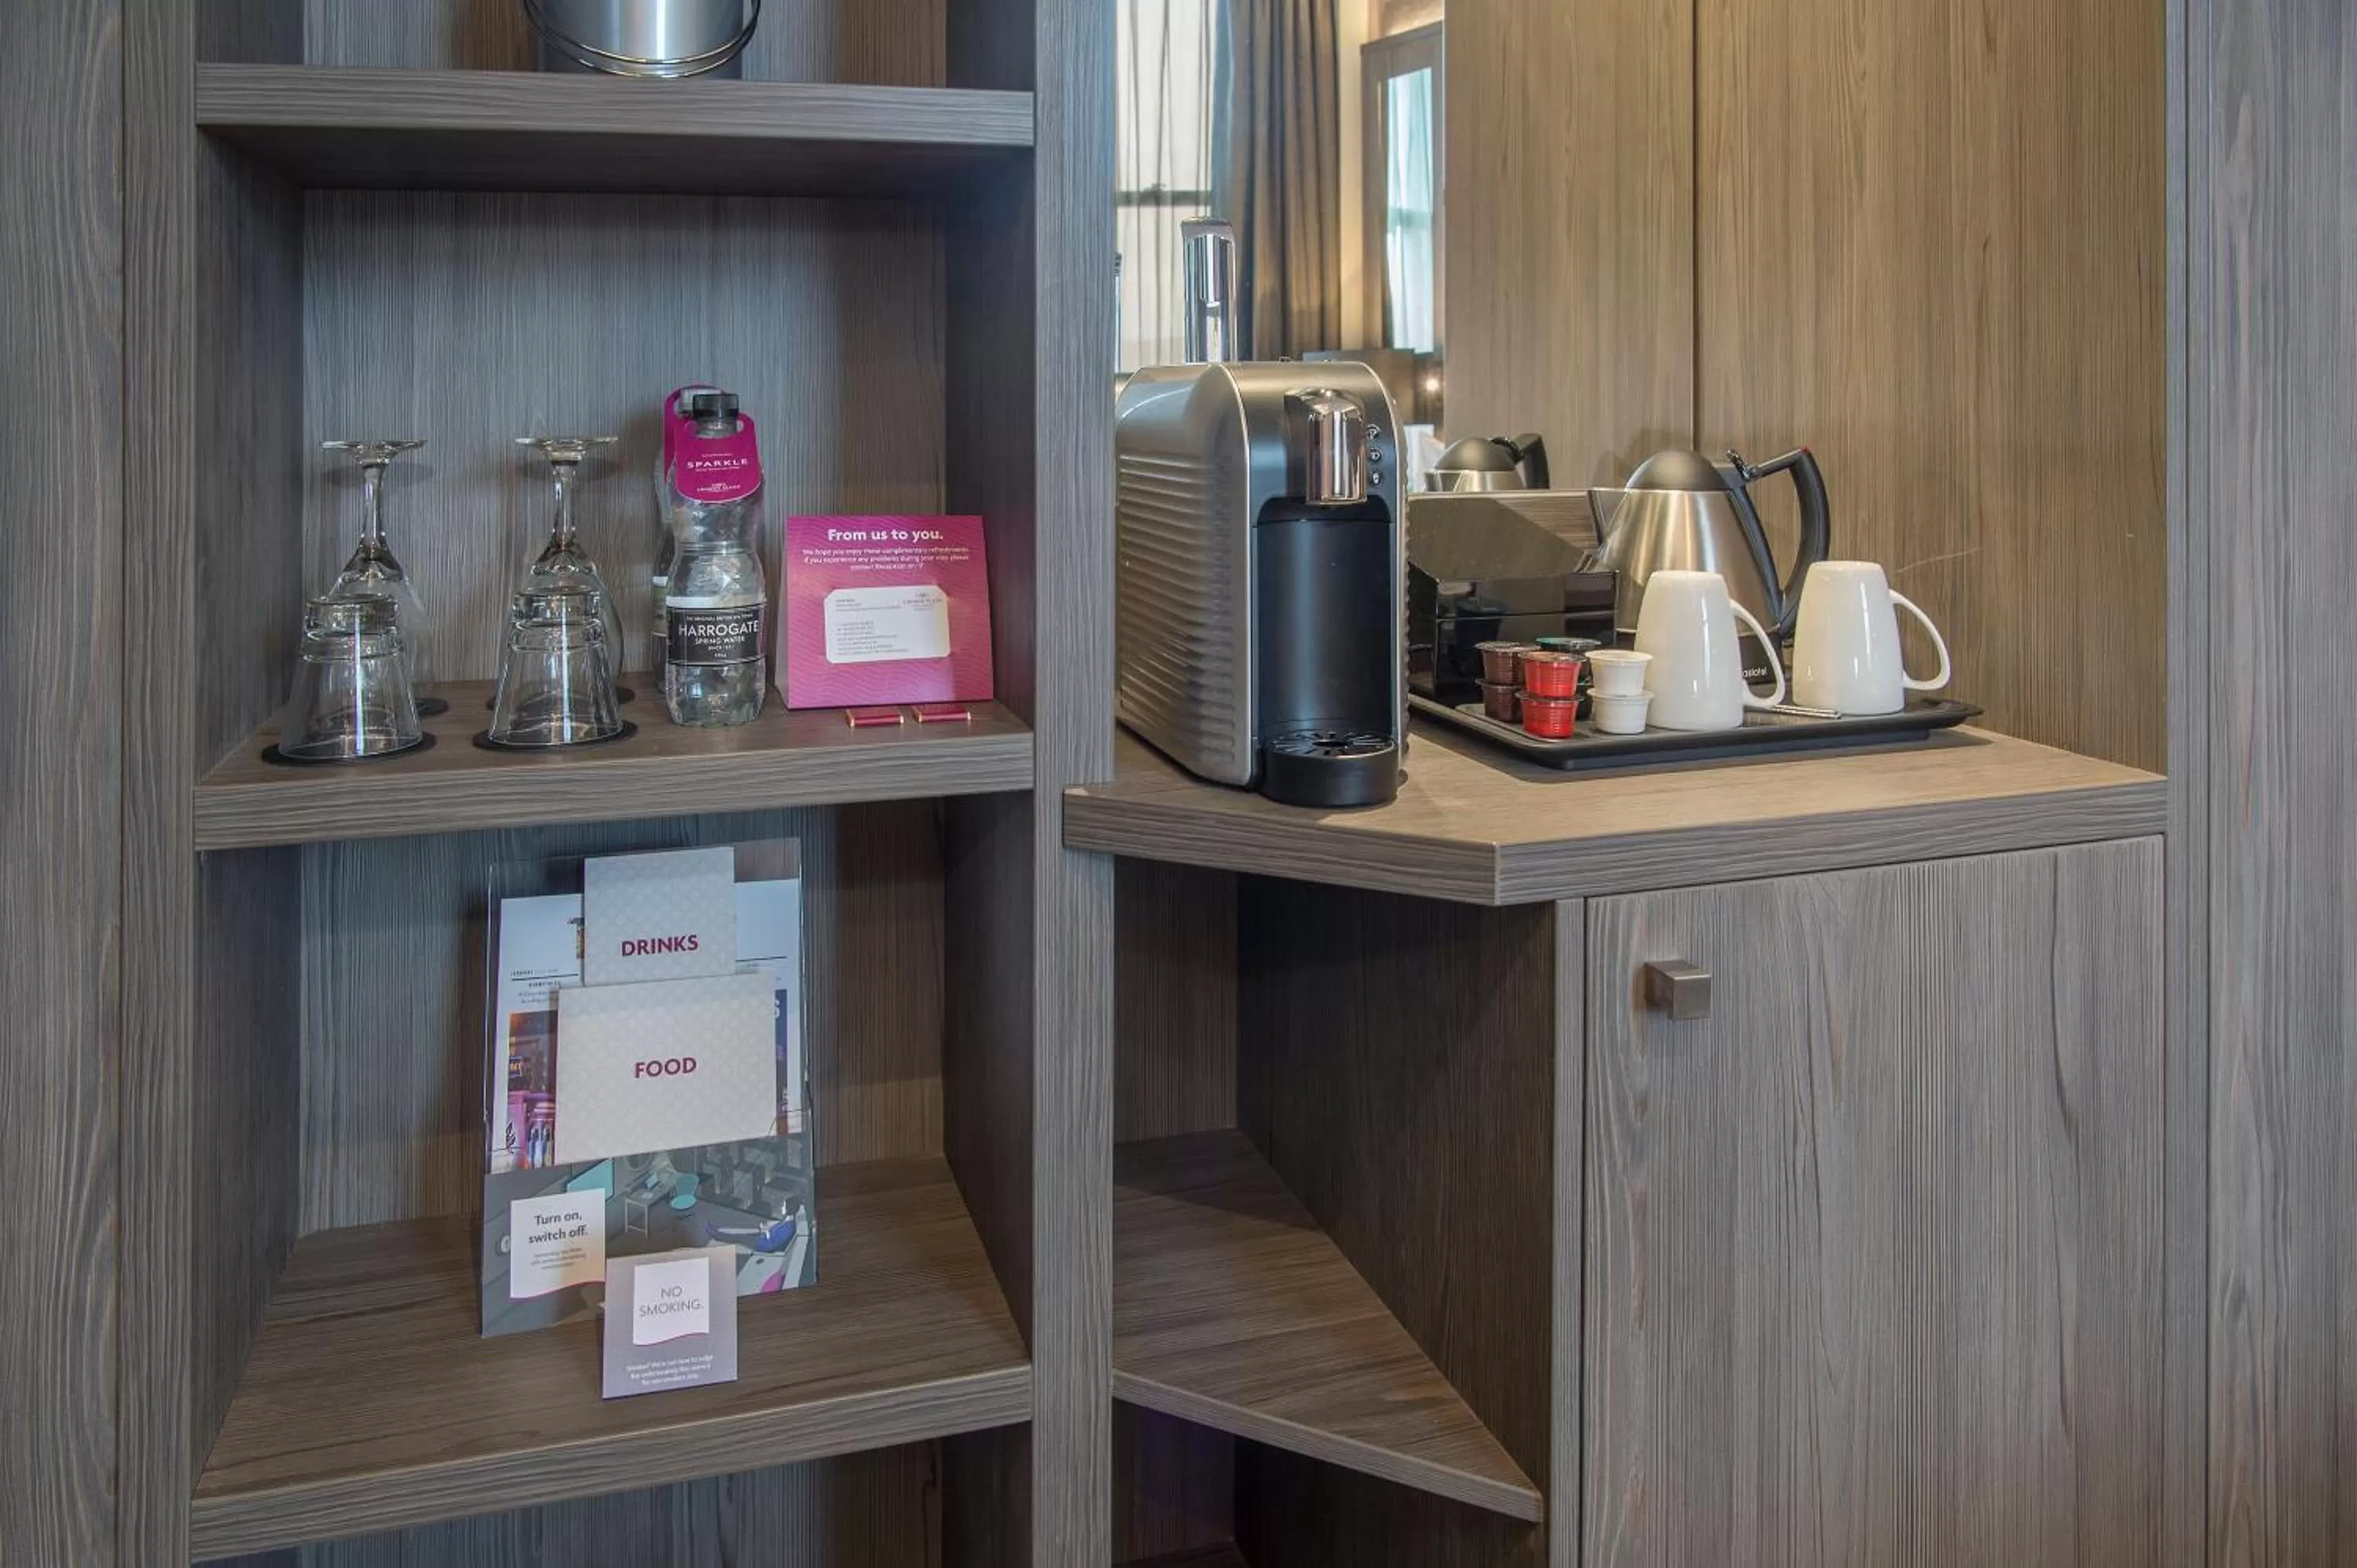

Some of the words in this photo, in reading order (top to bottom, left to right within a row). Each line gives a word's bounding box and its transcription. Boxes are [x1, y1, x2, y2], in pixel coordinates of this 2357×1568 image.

[687, 458, 748, 469] SPARKLE
[828, 529, 867, 541] From
[871, 530, 888, 540] us
[891, 529, 908, 540] to
[912, 530, 944, 544] you.
[679, 620, 759, 637] HARROGATE
[621, 934, 698, 957] DRINKS
[635, 1057, 697, 1079] FOOD
[534, 1214, 561, 1225] Turn
[564, 1212, 582, 1222] on,
[529, 1228, 566, 1244] switch
[569, 1224, 588, 1238] off.
[661, 1285, 683, 1299] NO
